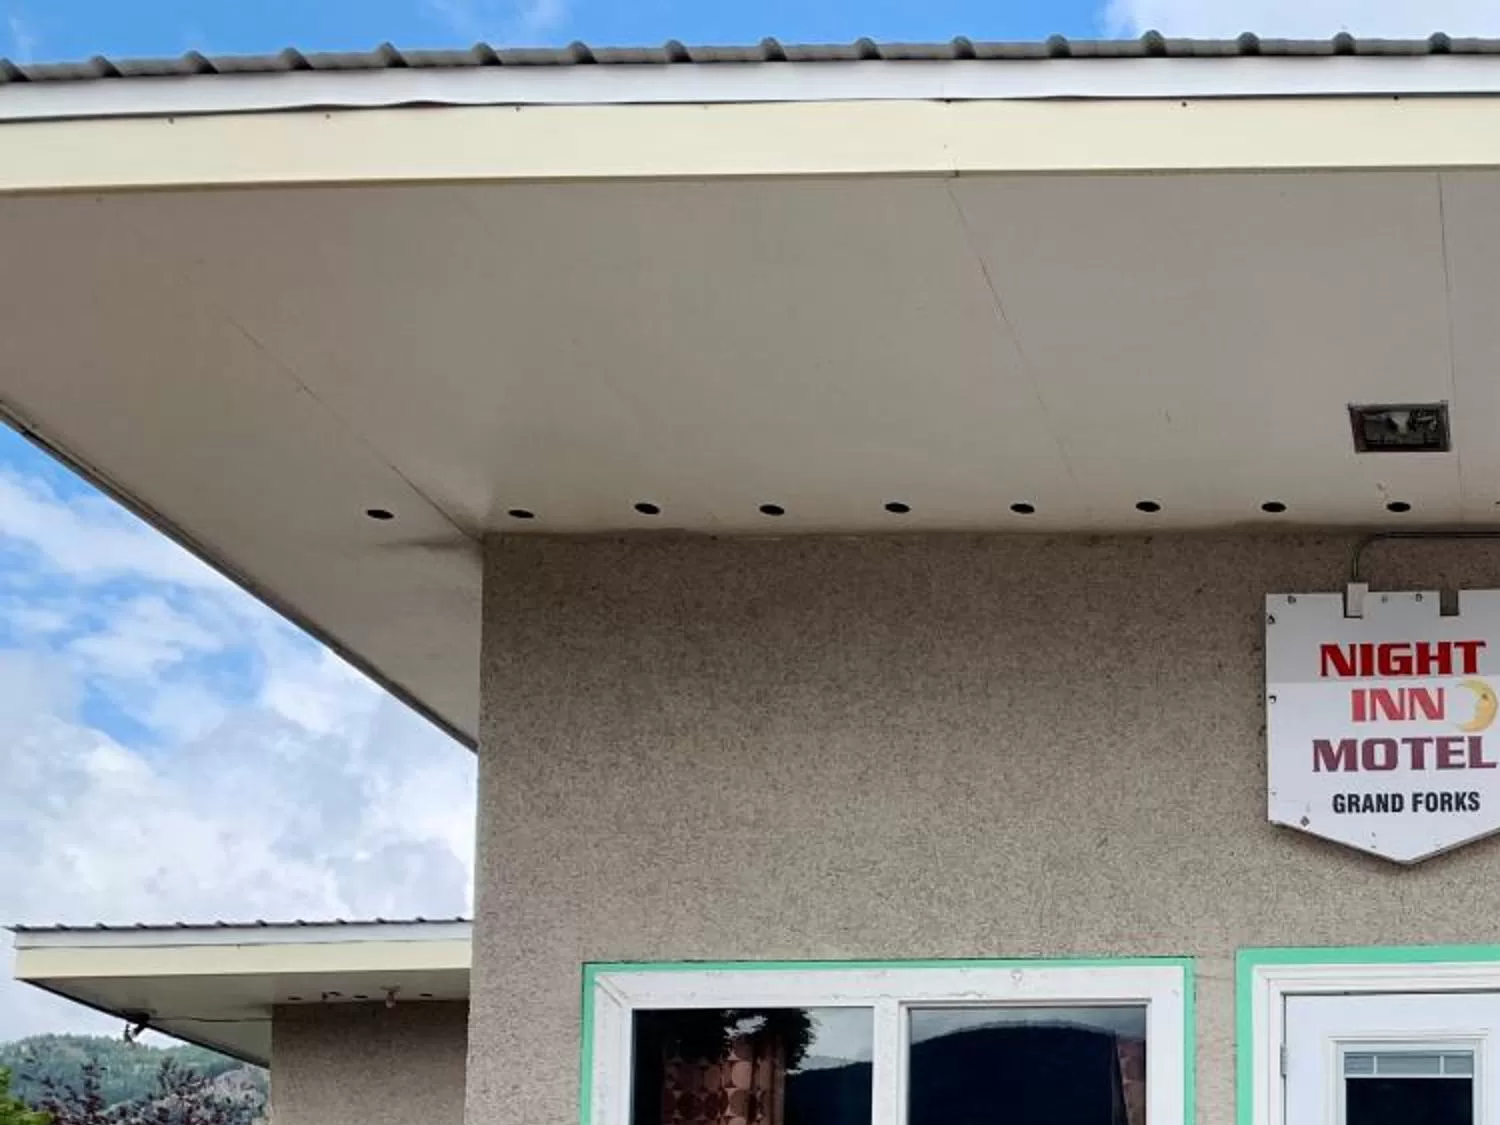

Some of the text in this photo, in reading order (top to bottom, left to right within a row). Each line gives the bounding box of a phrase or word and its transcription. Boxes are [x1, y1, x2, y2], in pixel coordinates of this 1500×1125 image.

[1319, 640, 1487, 677] NIGHT
[1351, 687, 1445, 722] INN
[1312, 735, 1498, 772] MOTEL
[1332, 791, 1481, 814] GRAND FORKS
